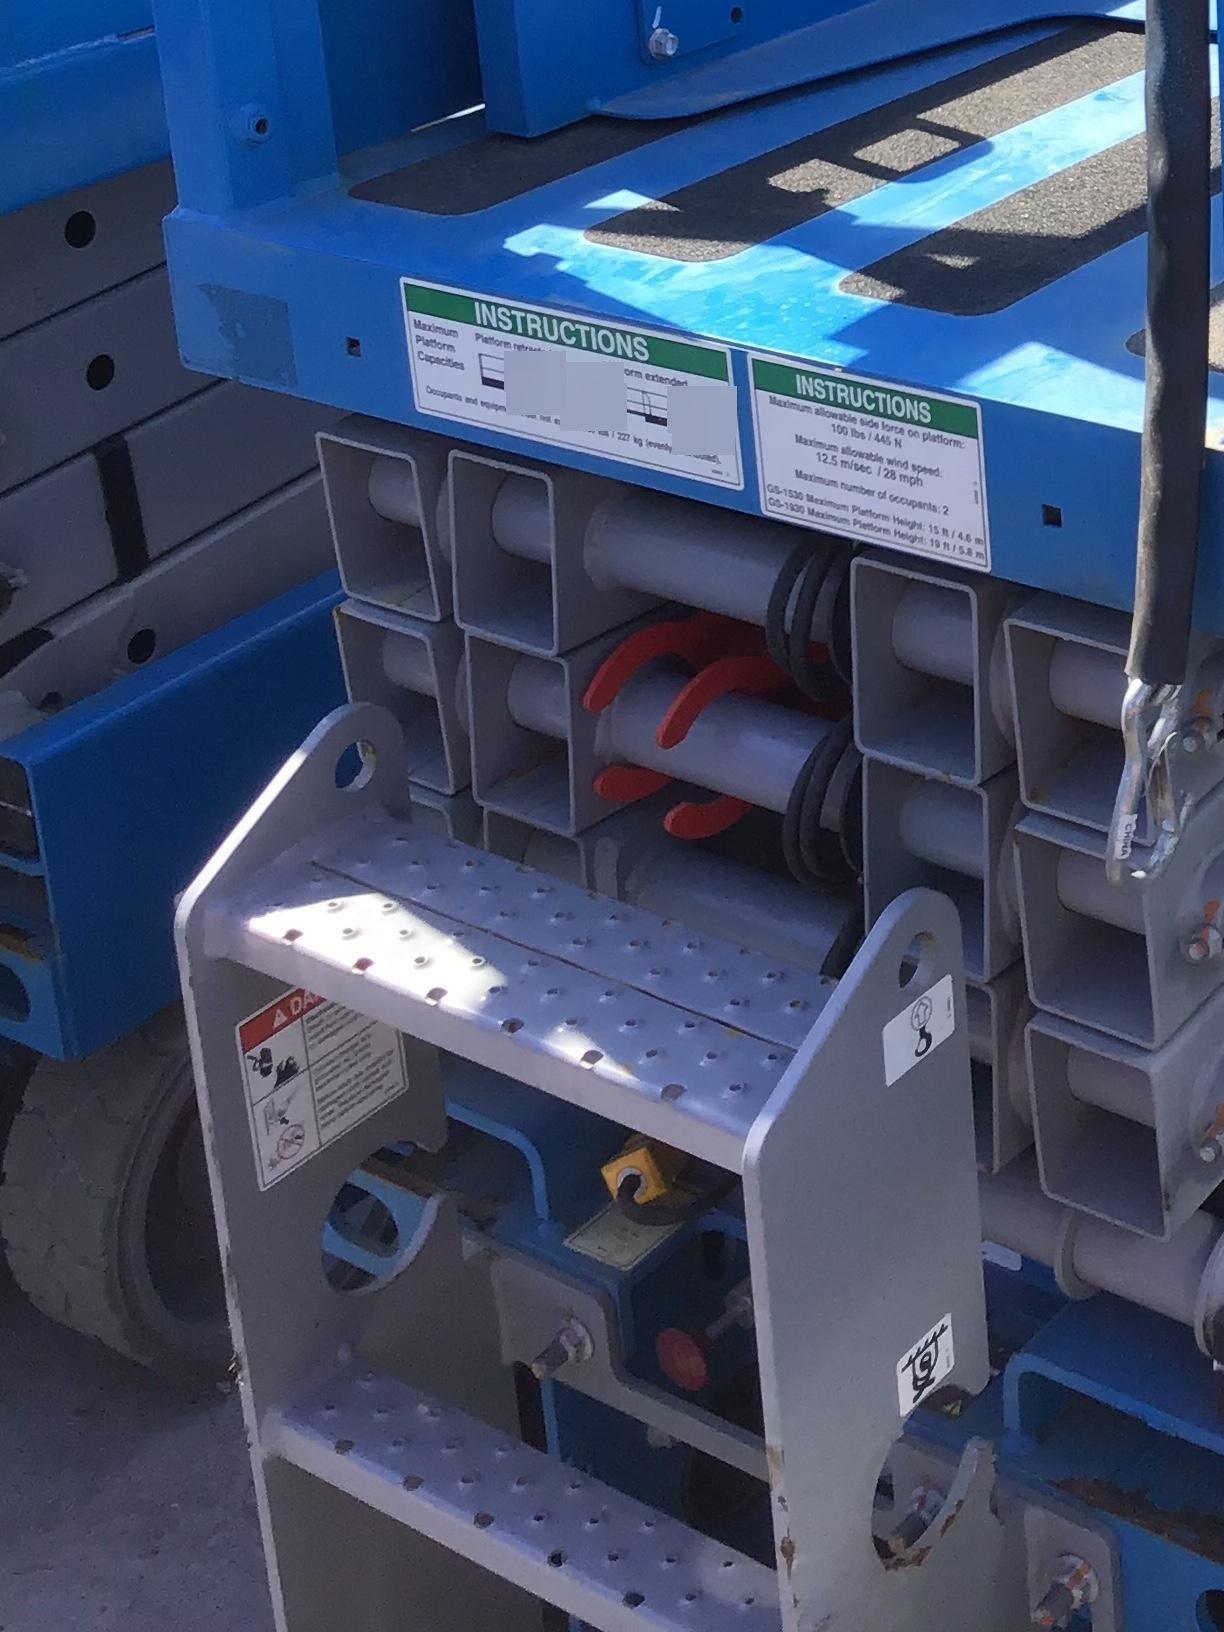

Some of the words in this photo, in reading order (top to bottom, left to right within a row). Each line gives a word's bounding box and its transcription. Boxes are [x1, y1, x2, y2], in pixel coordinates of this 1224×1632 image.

[413, 318, 458, 338] Maximum
[474, 332, 511, 350] Platform
[415, 334, 455, 353] Platform
[473, 301, 650, 362] INSTRUCTIONS
[417, 350, 464, 371] Capacities
[795, 374, 931, 423] INSTRUCTIONS
[768, 395, 812, 414] Maximum
[814, 405, 856, 424] allowable
[859, 415, 878, 429] side
[881, 420, 904, 435] force
[907, 428, 919, 439] on
[795, 434, 838, 453] Maximum
[840, 444, 883, 464] allowable
[886, 455, 907, 469] wind
[831, 424, 848, 436] 100
[850, 428, 865, 440] lbs
[874, 433, 891, 446] 445
[816, 452, 837, 466] 12.5
[840, 458, 871, 475] m/sec
[883, 468, 896, 480] 28
[899, 472, 923, 489] mph
[795, 469, 838, 488] Maximum
[840, 480, 874, 497] number
[877, 489, 886, 500] of
[943, 505, 949, 515] 2
[806, 493, 848, 512] Maximum
[851, 504, 889, 522] Platform
[807, 507, 849, 525] Maximum
[852, 518, 890, 536] Platform
